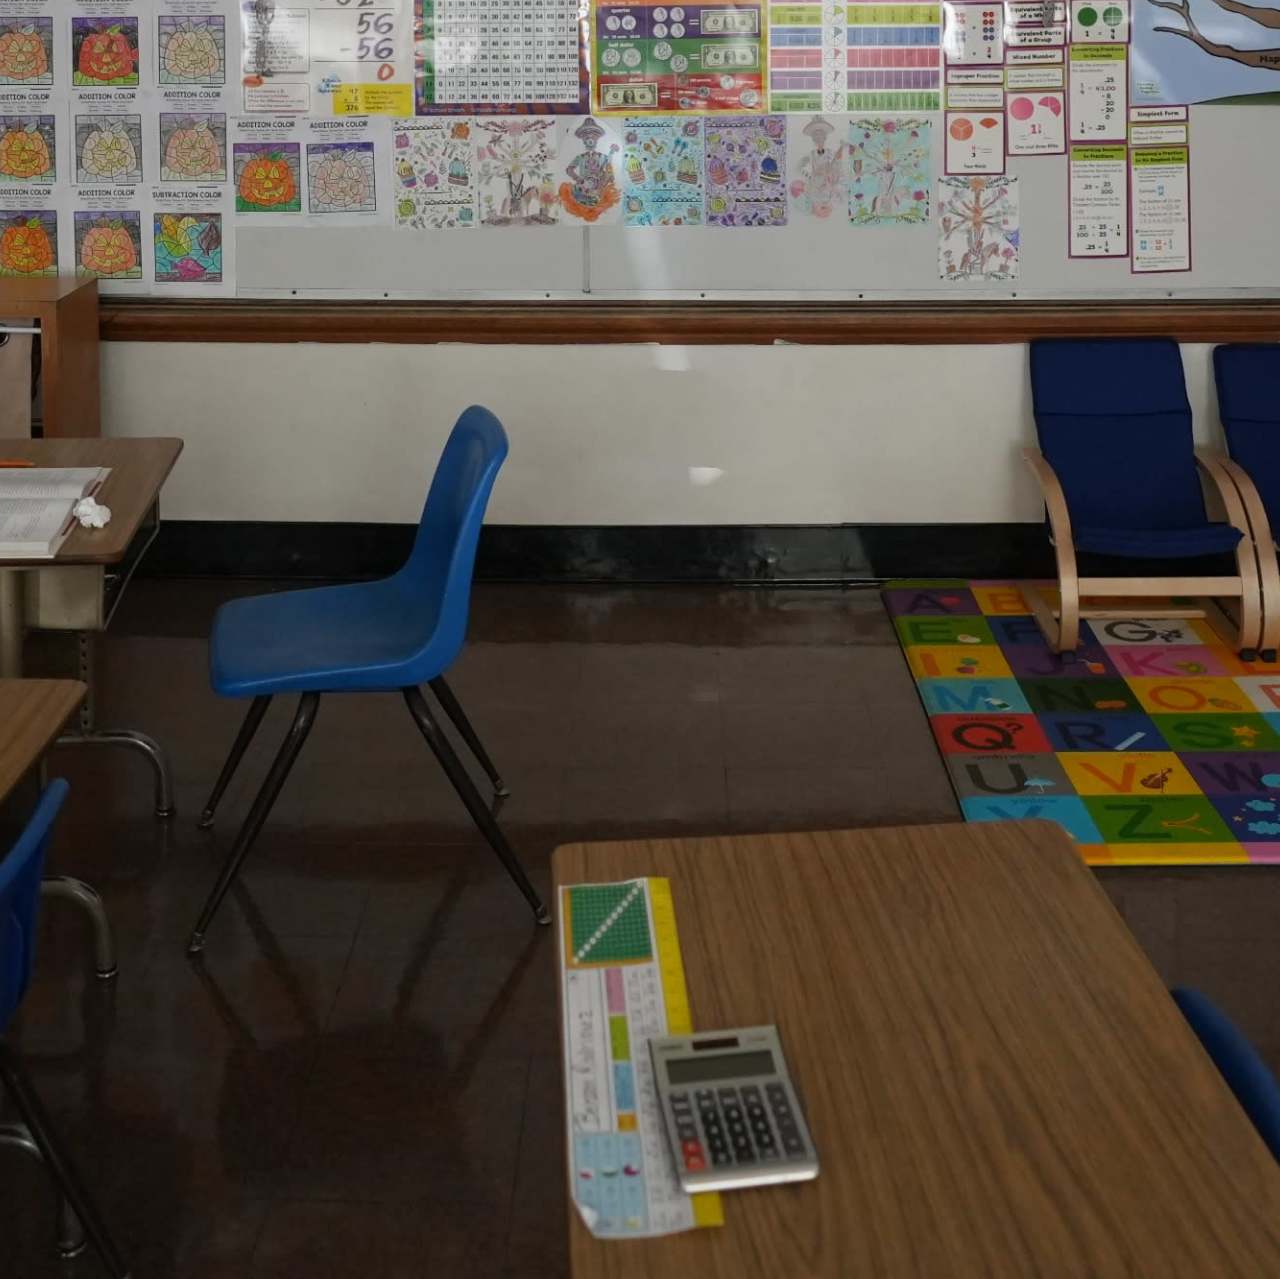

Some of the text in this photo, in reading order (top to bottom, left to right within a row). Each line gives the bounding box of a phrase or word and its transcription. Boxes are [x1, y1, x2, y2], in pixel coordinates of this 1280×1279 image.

[357, 13, 394, 34] 56
[30, 188, 51, 196] COLOR
[78, 189, 111, 197] ADDITION
[905, 592, 954, 614] A
[911, 621, 948, 643] E
[1105, 620, 1157, 643] G
[1120, 651, 1173, 676] K
[935, 685, 999, 711] M
[1039, 685, 1096, 711] N
[1149, 685, 1207, 711] O
[952, 722, 1016, 750] Q
[1057, 721, 1115, 748] R
[1172, 720, 1233, 747] S
[965, 763, 1025, 793] U
[1079, 762, 1136, 793] V
[1193, 761, 1263, 791] W
[1104, 804, 1173, 839] Z
